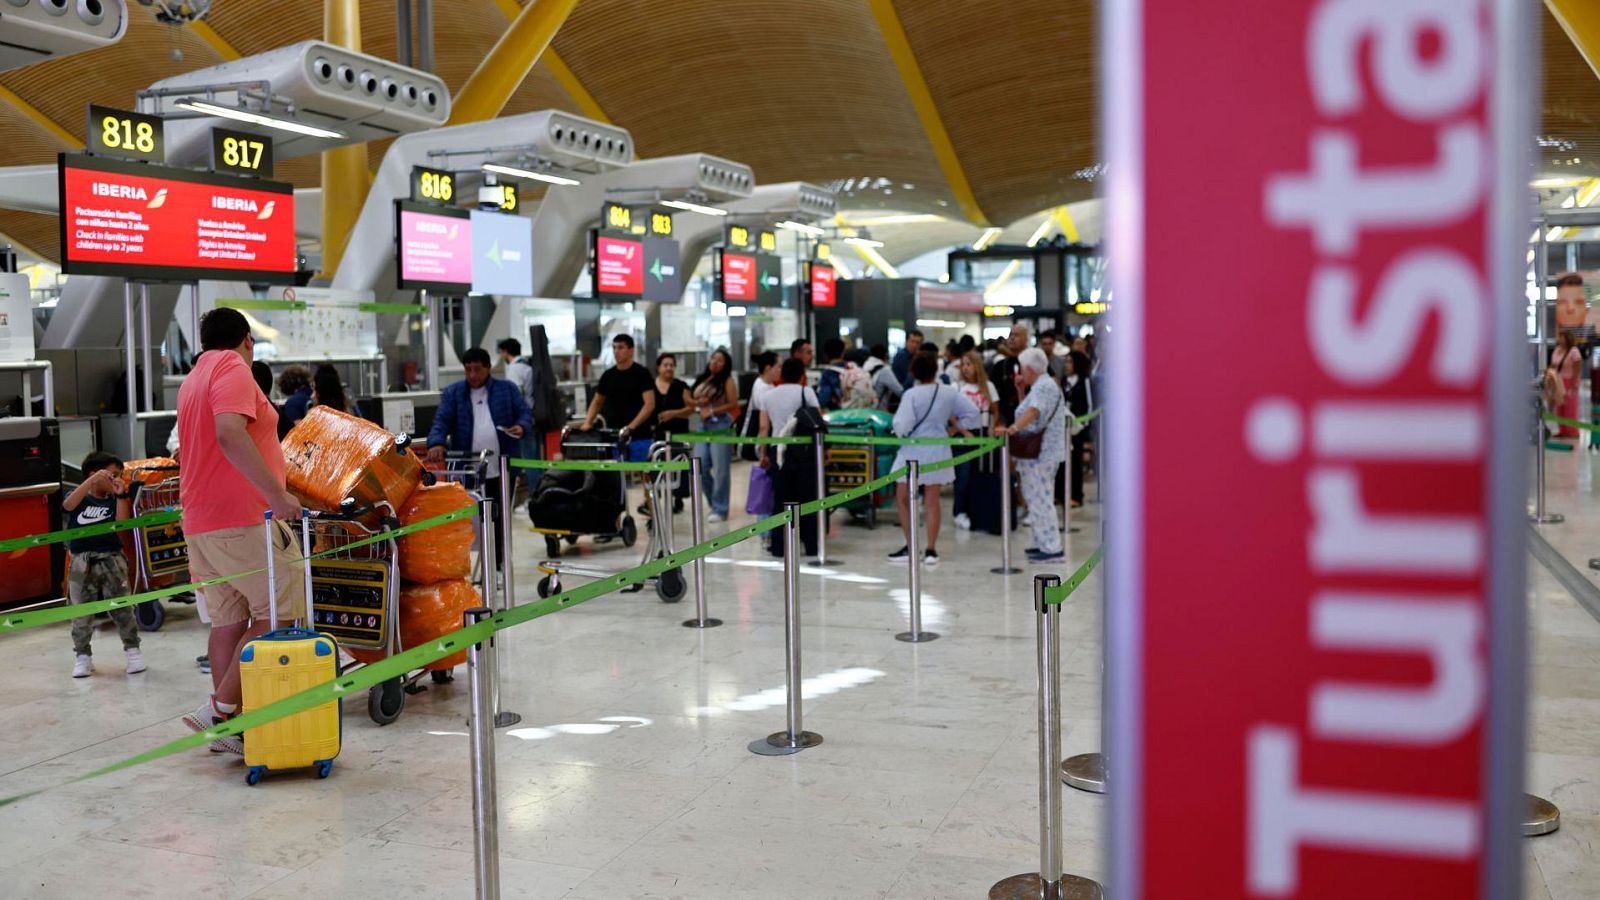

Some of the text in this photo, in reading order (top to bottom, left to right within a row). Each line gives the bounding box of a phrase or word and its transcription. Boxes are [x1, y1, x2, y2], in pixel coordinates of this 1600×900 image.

[102, 116, 154, 152] 818
[223, 137, 264, 169] 817
[92, 182, 147, 200] IBERIA
[421, 172, 452, 200] 816
[212, 196, 258, 212] IBERIA
[75, 206, 142, 221] Facturación familias
[108, 219, 127, 229] hasta
[127, 221, 133, 230] 2
[76, 230, 144, 242] Check in families with
[76, 240, 144, 253] children up to 2 years
[1246, 0, 1488, 895] Turista
[83, 505, 110, 519] NIKE
